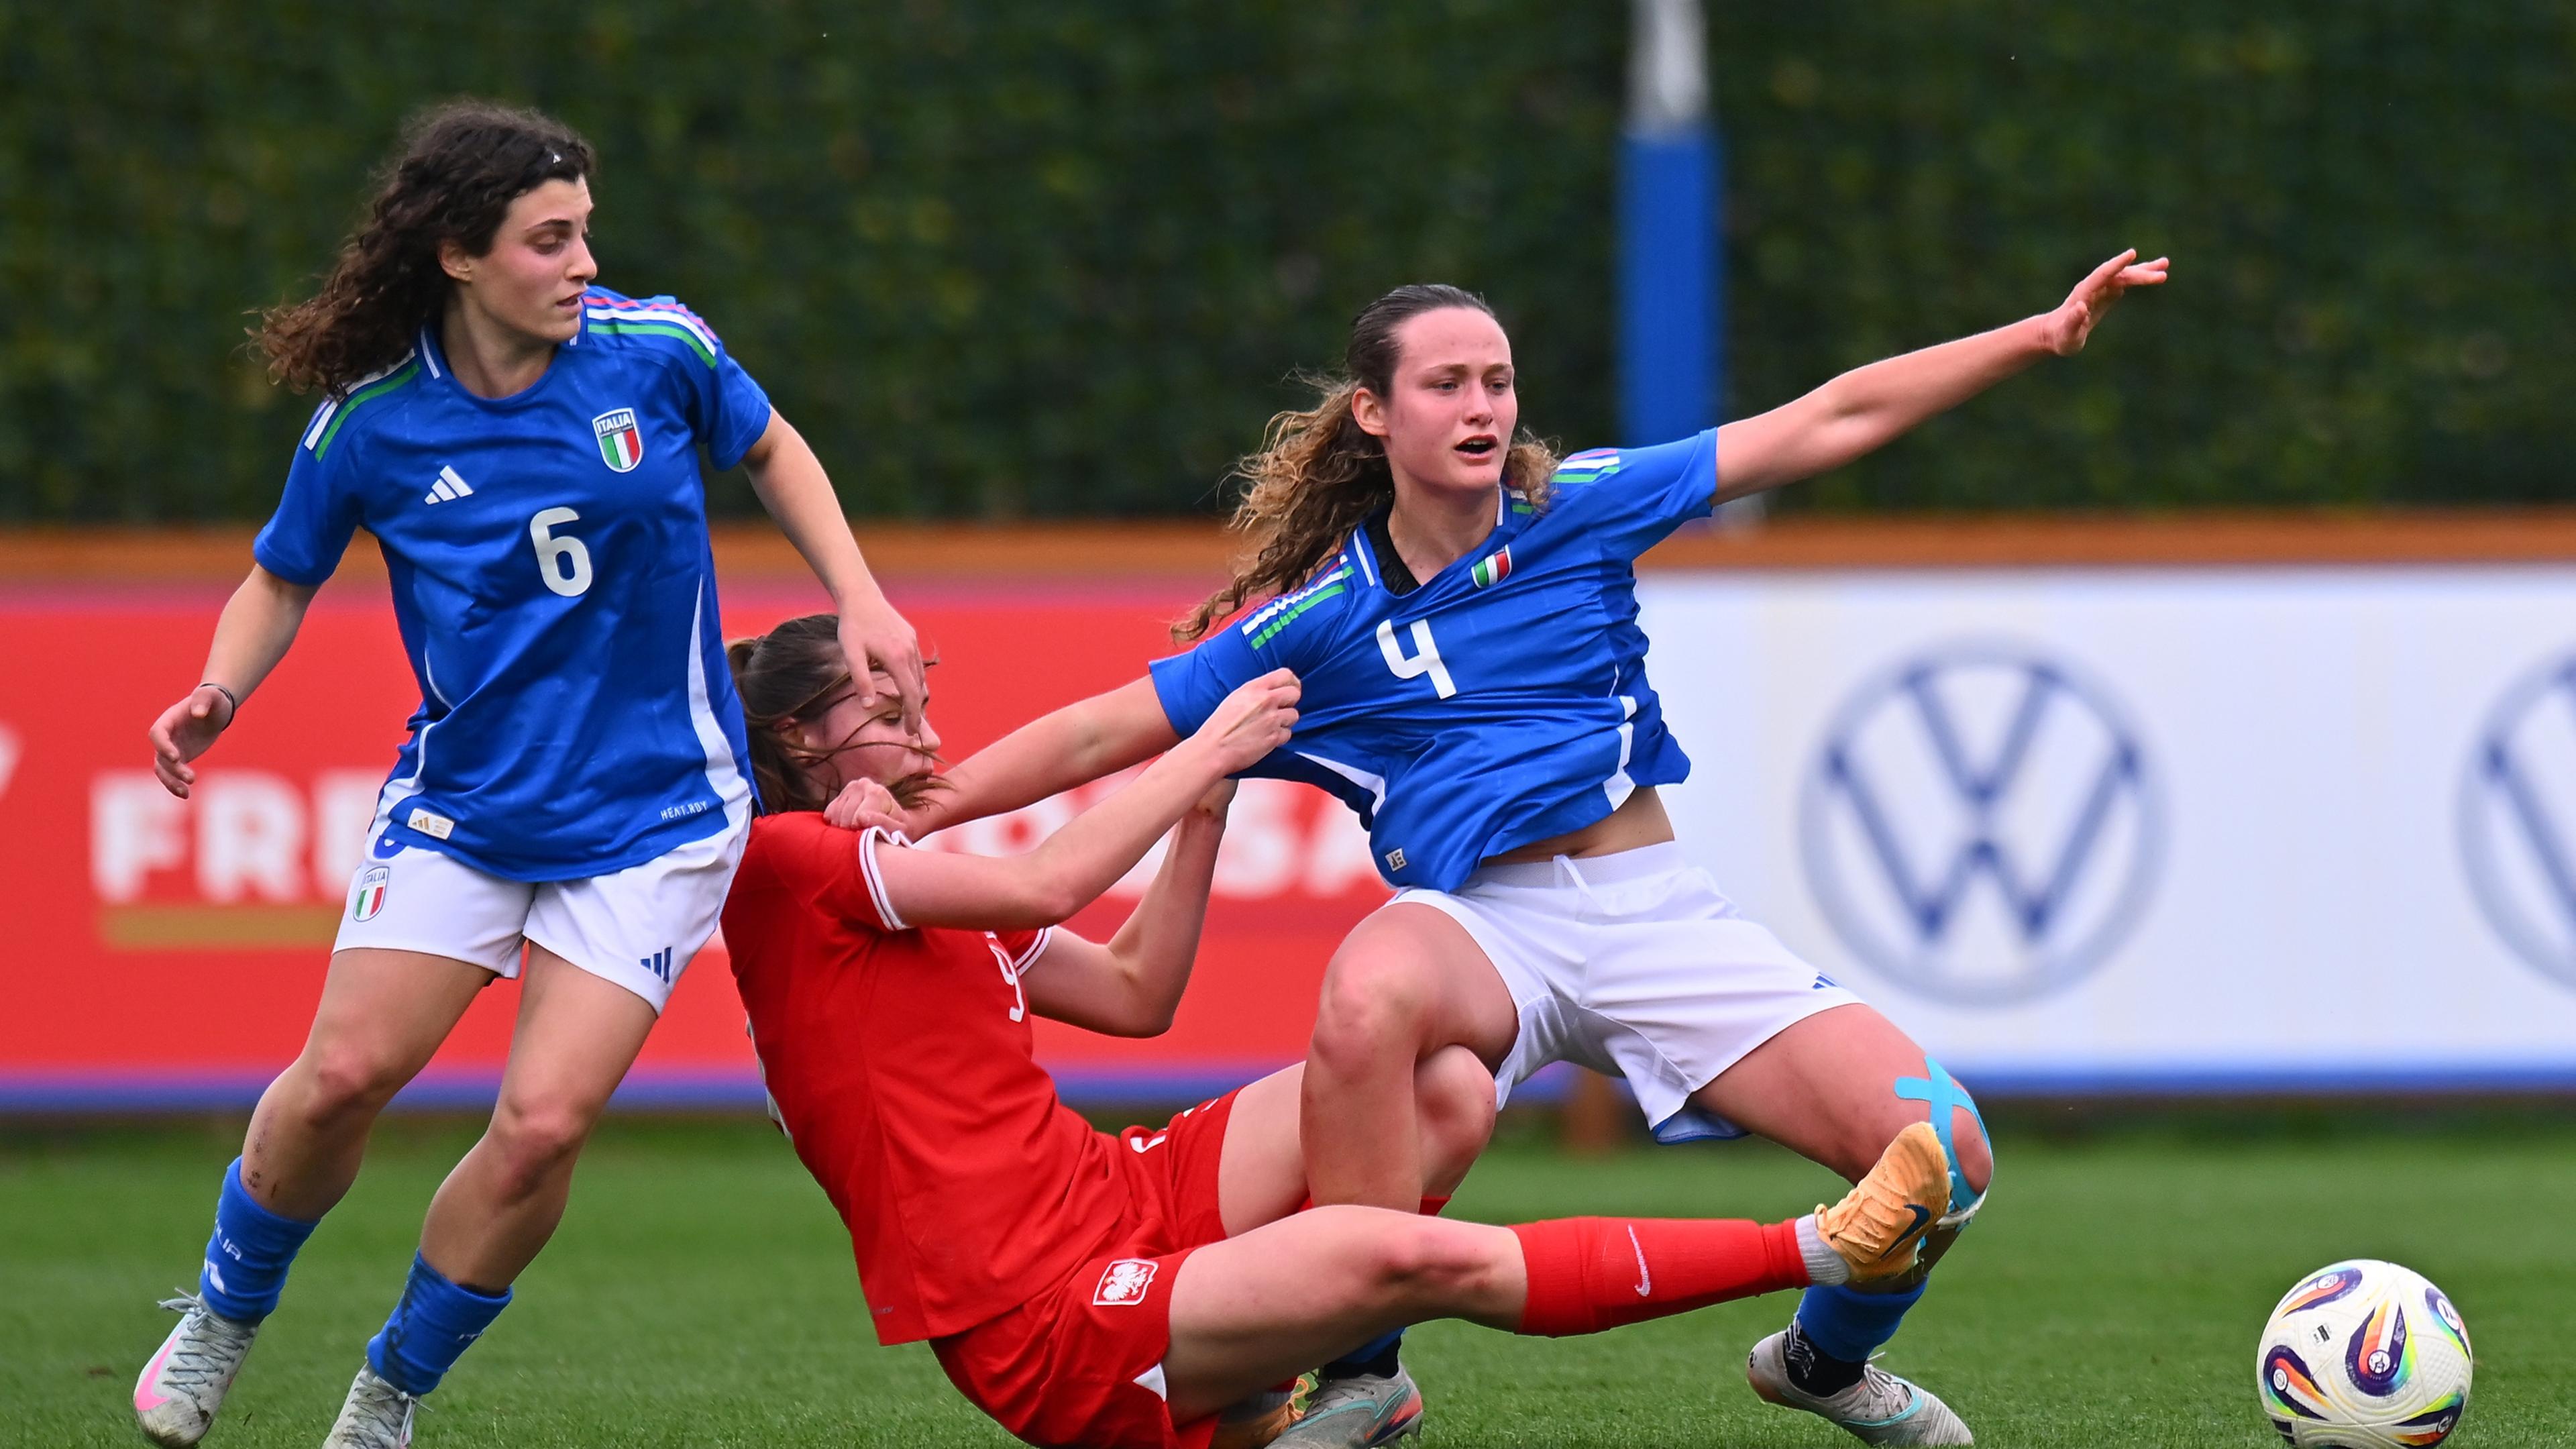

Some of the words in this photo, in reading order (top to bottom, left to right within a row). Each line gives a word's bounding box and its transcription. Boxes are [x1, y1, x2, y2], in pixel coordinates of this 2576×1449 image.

[596, 413, 631, 434] ITALIA
[529, 506, 594, 597] 6
[1376, 619, 1457, 700] 4
[660, 800, 708, 820] HEAT.RDY
